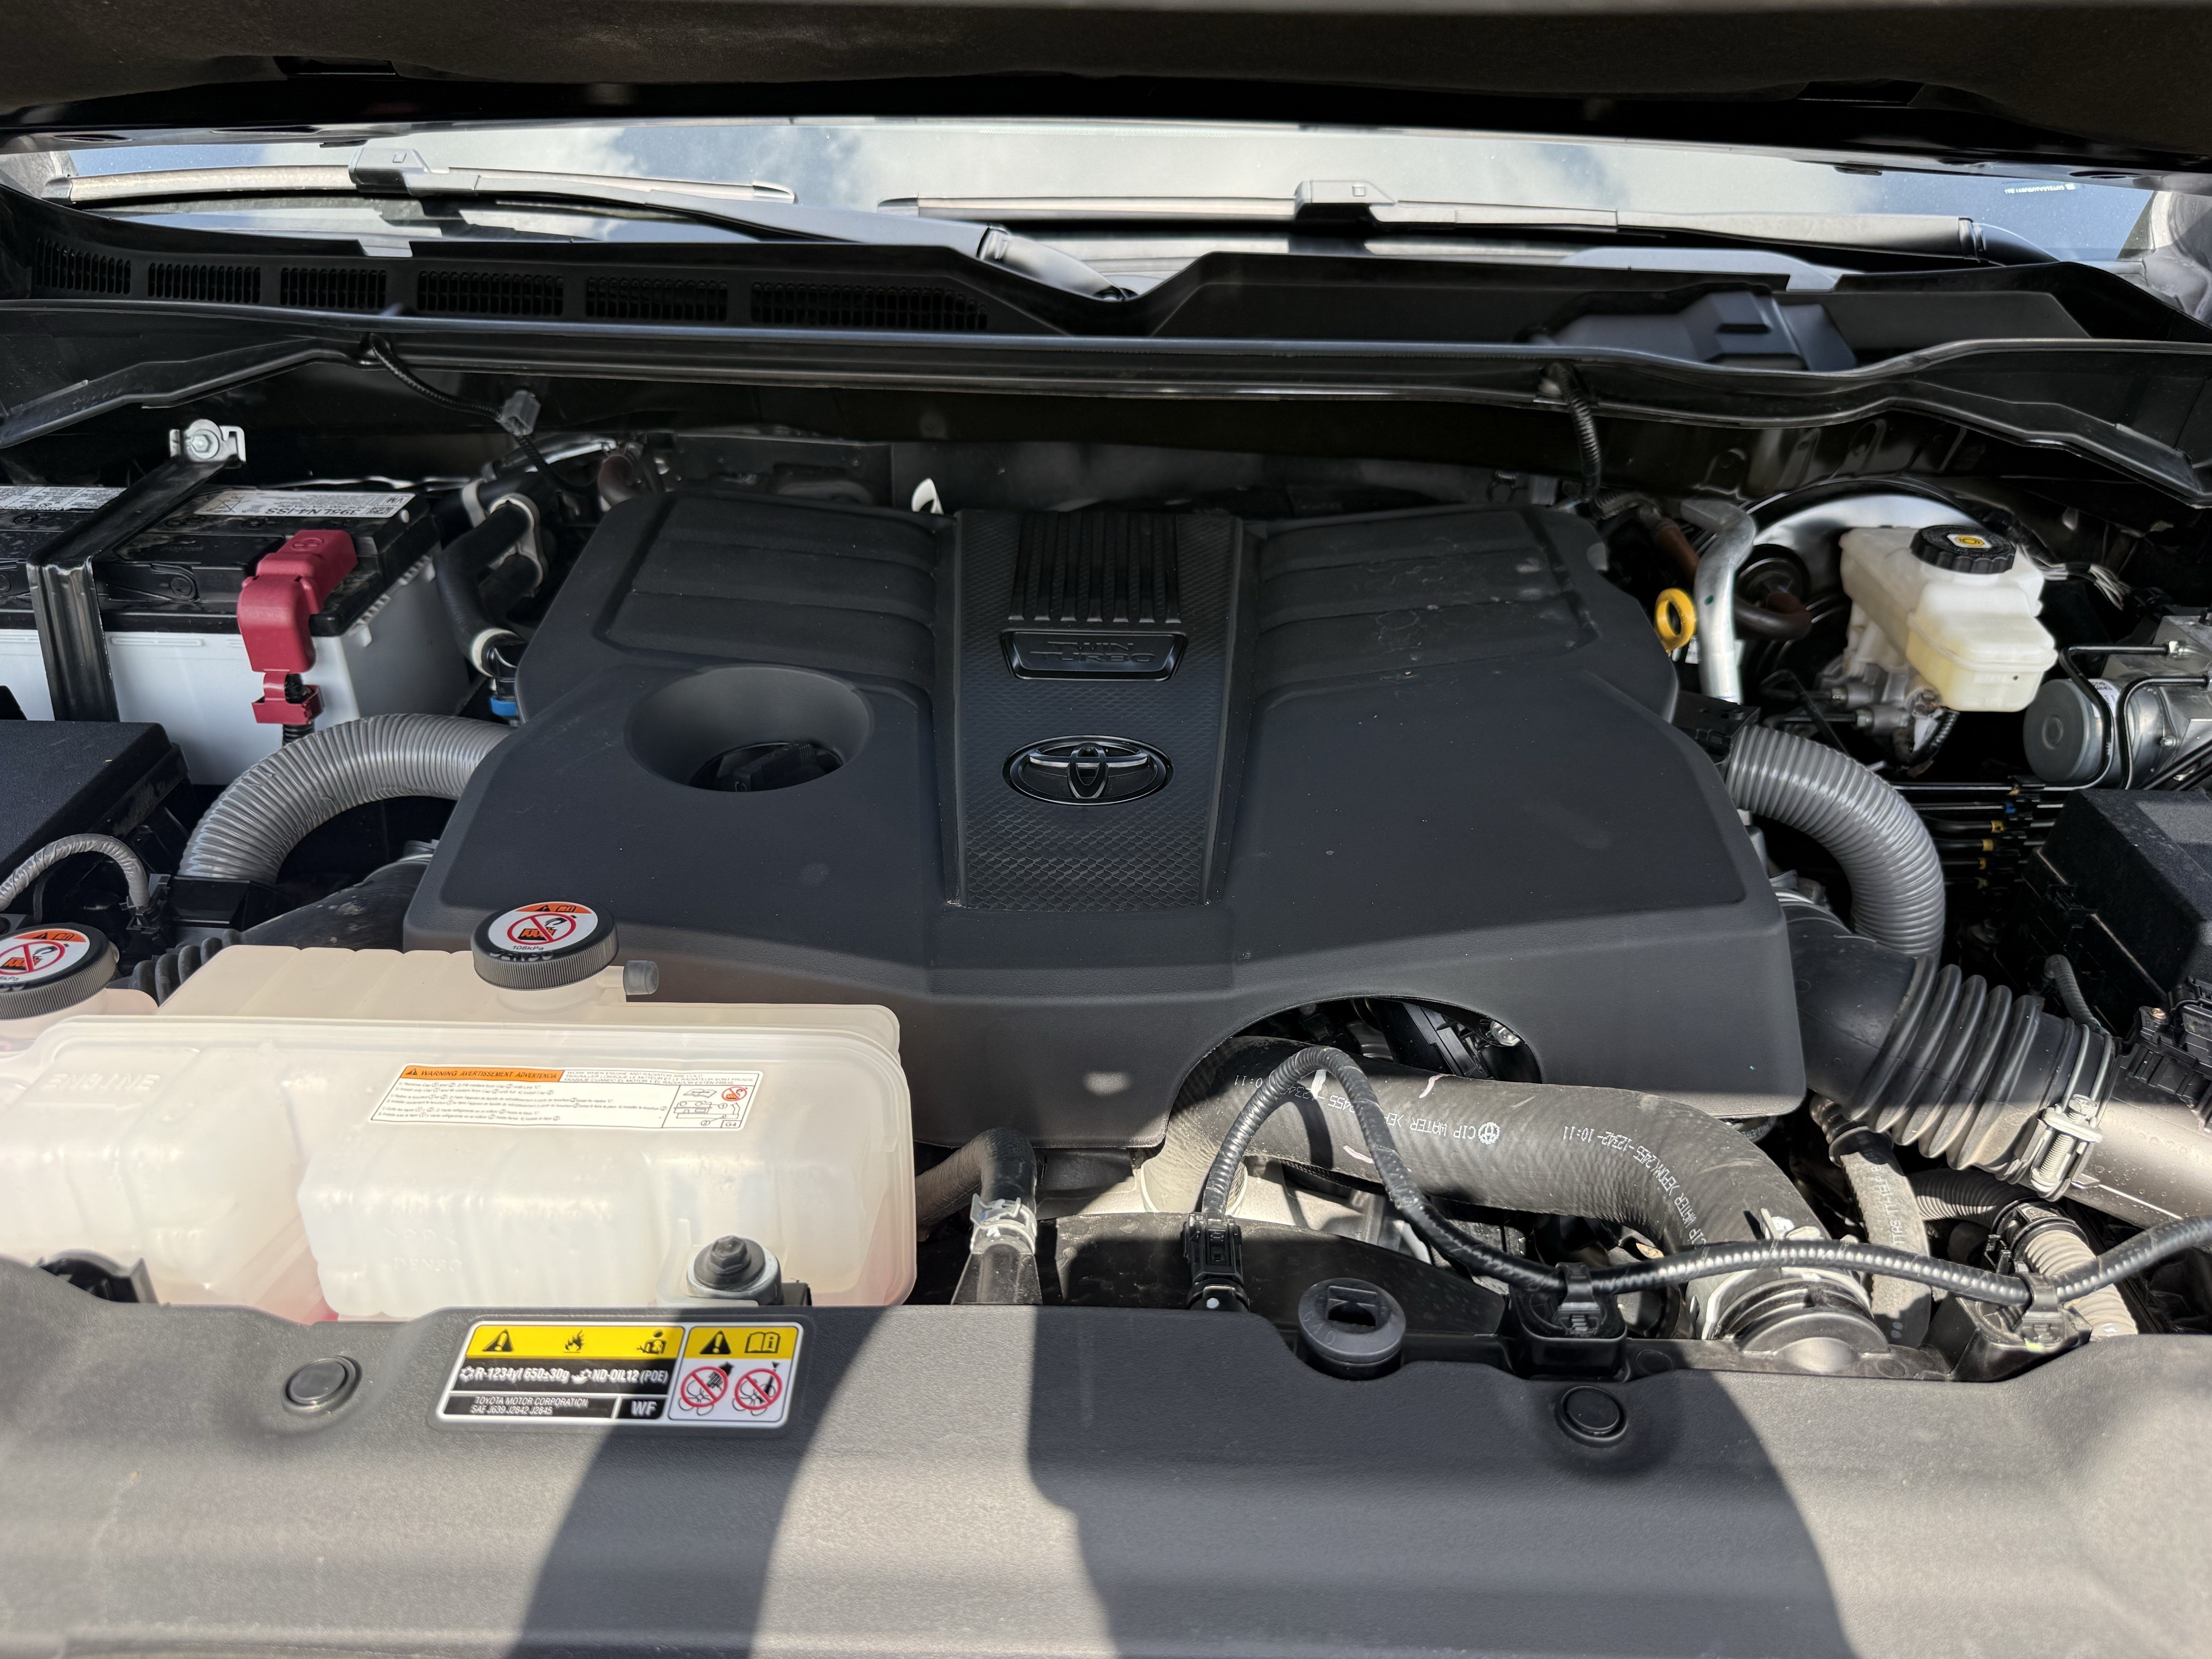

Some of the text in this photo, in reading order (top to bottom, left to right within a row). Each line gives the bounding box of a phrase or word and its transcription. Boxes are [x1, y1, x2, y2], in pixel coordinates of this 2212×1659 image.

[1408, 1116, 1448, 1138] WATER
[1453, 1124, 1476, 1140] CIP
[1674, 1192, 1698, 1229] WATER
[474, 1367, 524, 1383] R-1234yf
[524, 1367, 570, 1384] 650±30g
[640, 1369, 669, 1384] (POE)
[475, 1396, 589, 1408] TOYOTA MOTOR CORPORATION
[631, 1400, 657, 1416] WF
[470, 1405, 553, 1416] SAE J639 J2842 J2845
